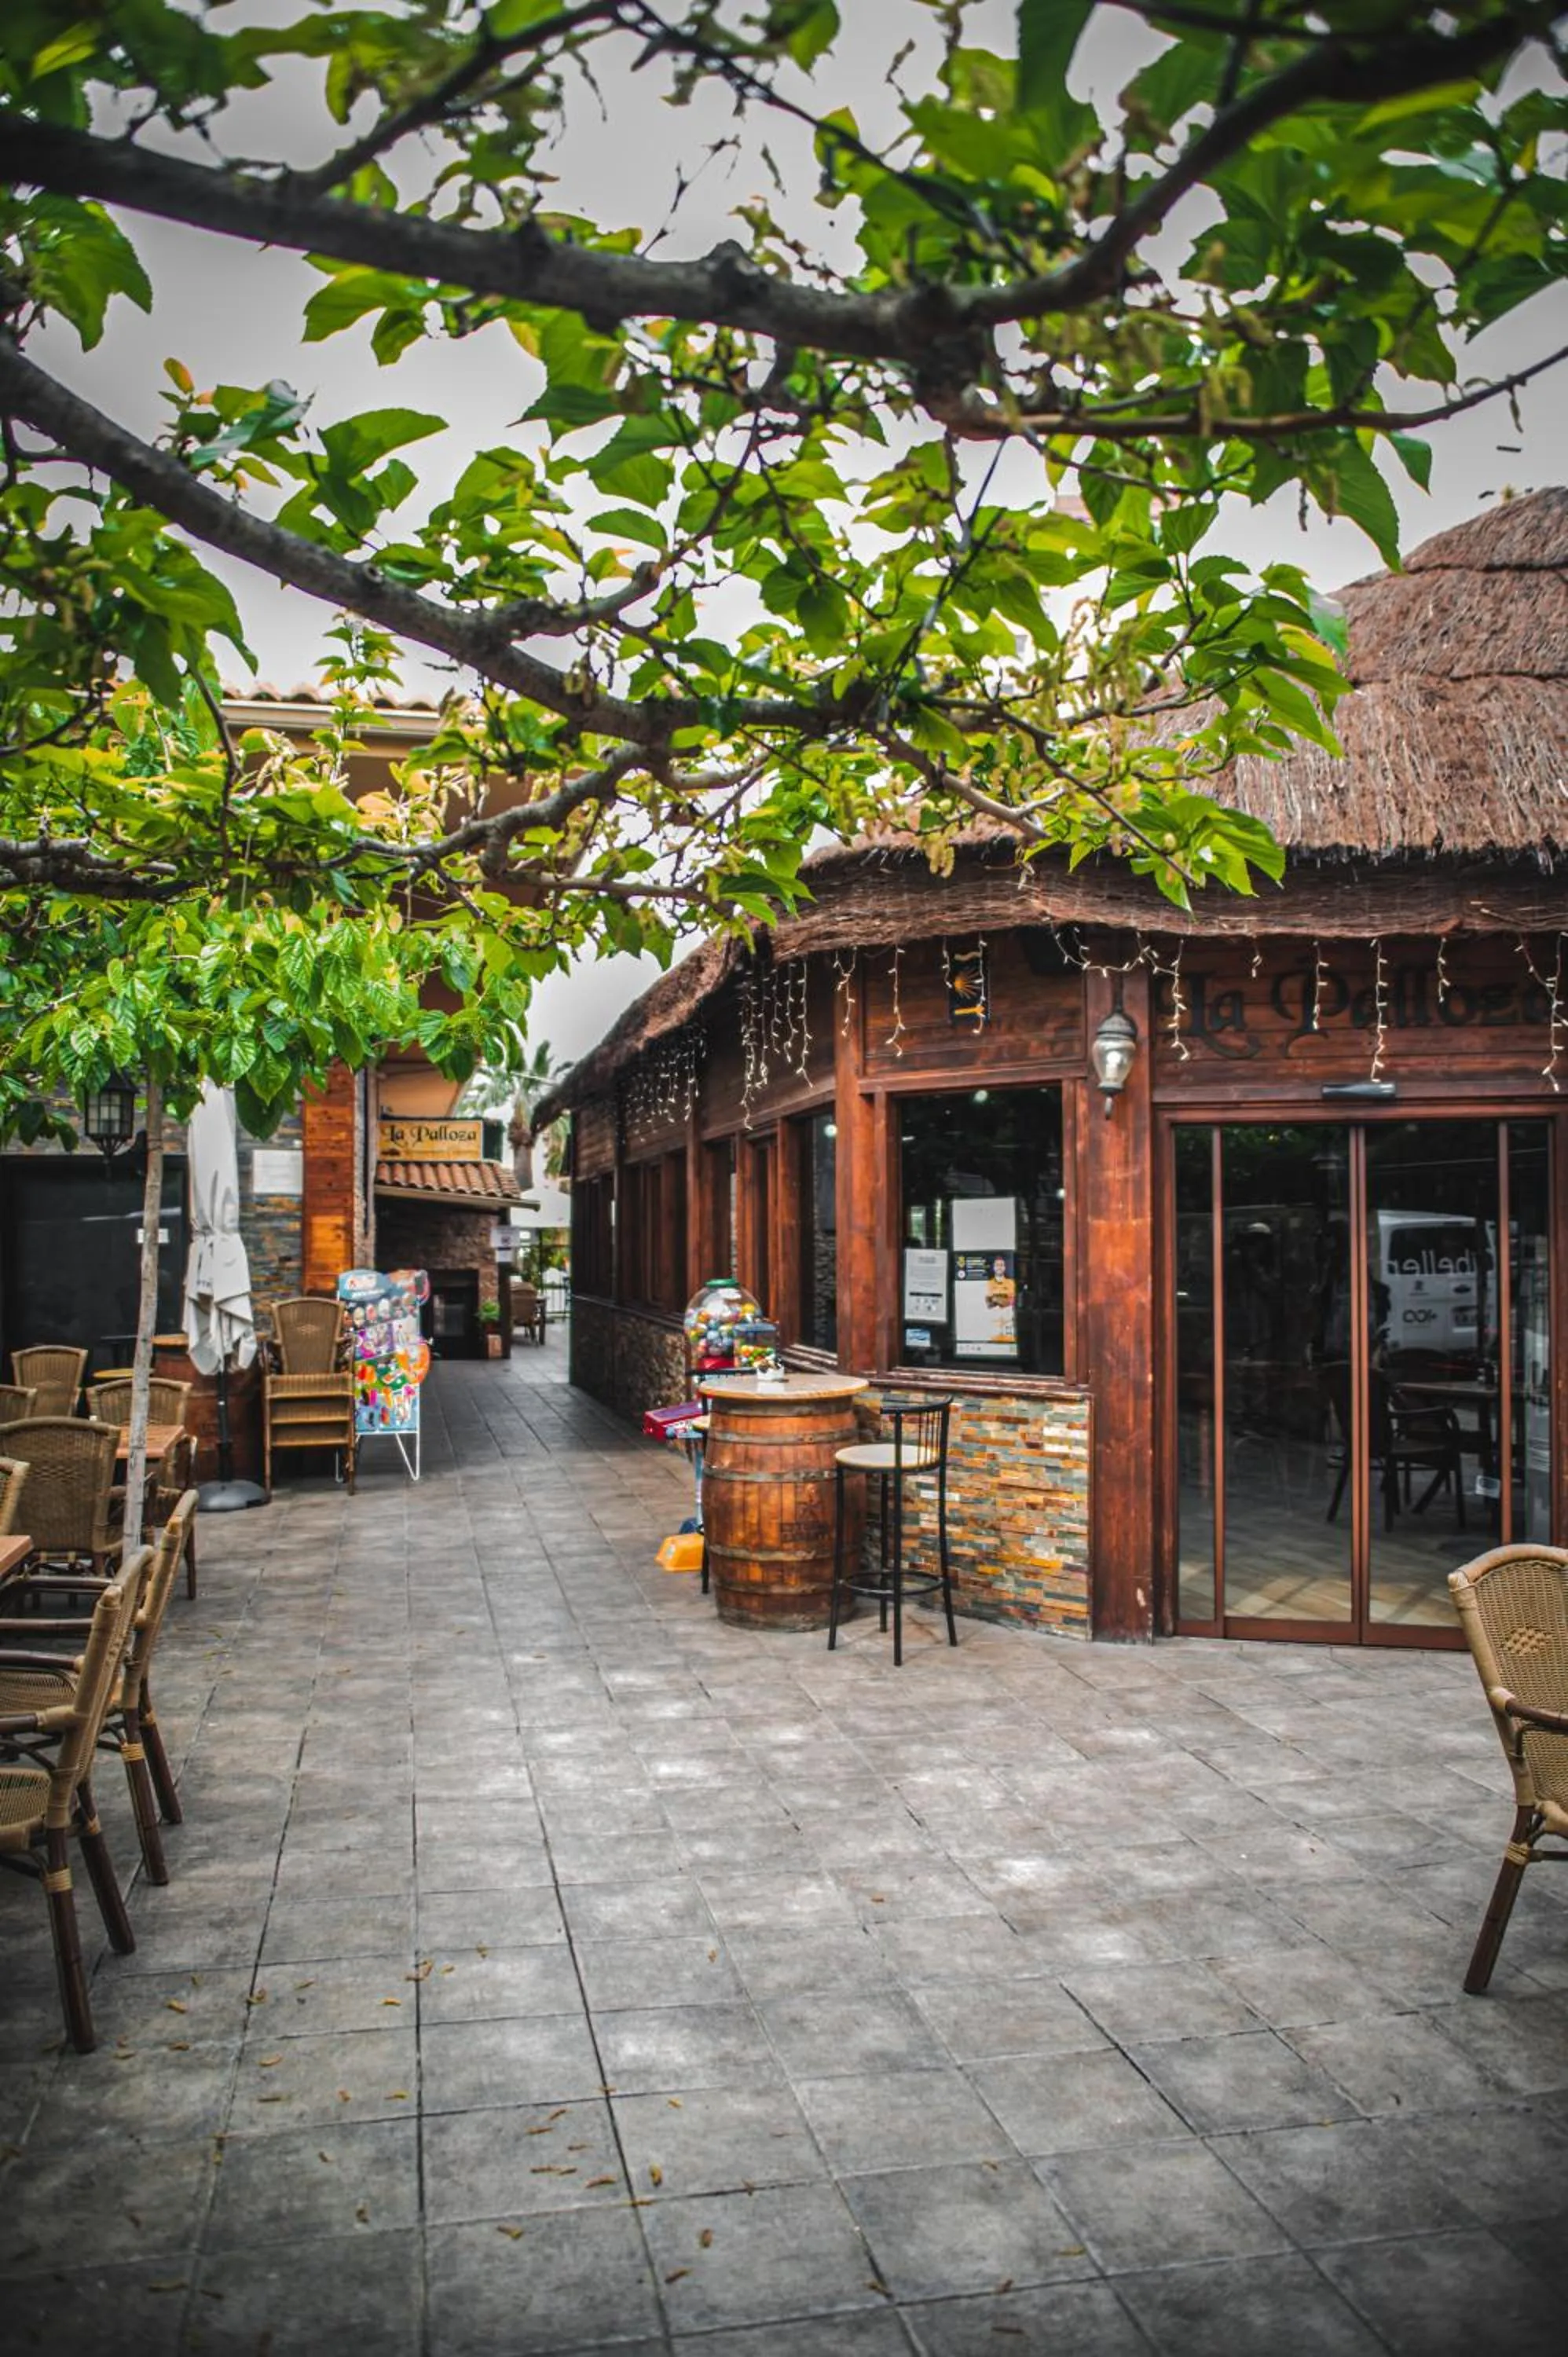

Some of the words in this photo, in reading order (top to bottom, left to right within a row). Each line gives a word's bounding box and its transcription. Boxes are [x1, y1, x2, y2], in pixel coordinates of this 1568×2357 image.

[1154, 970, 1258, 1059] La
[380, 1125, 408, 1147] La
[410, 1125, 477, 1147] Palloza
